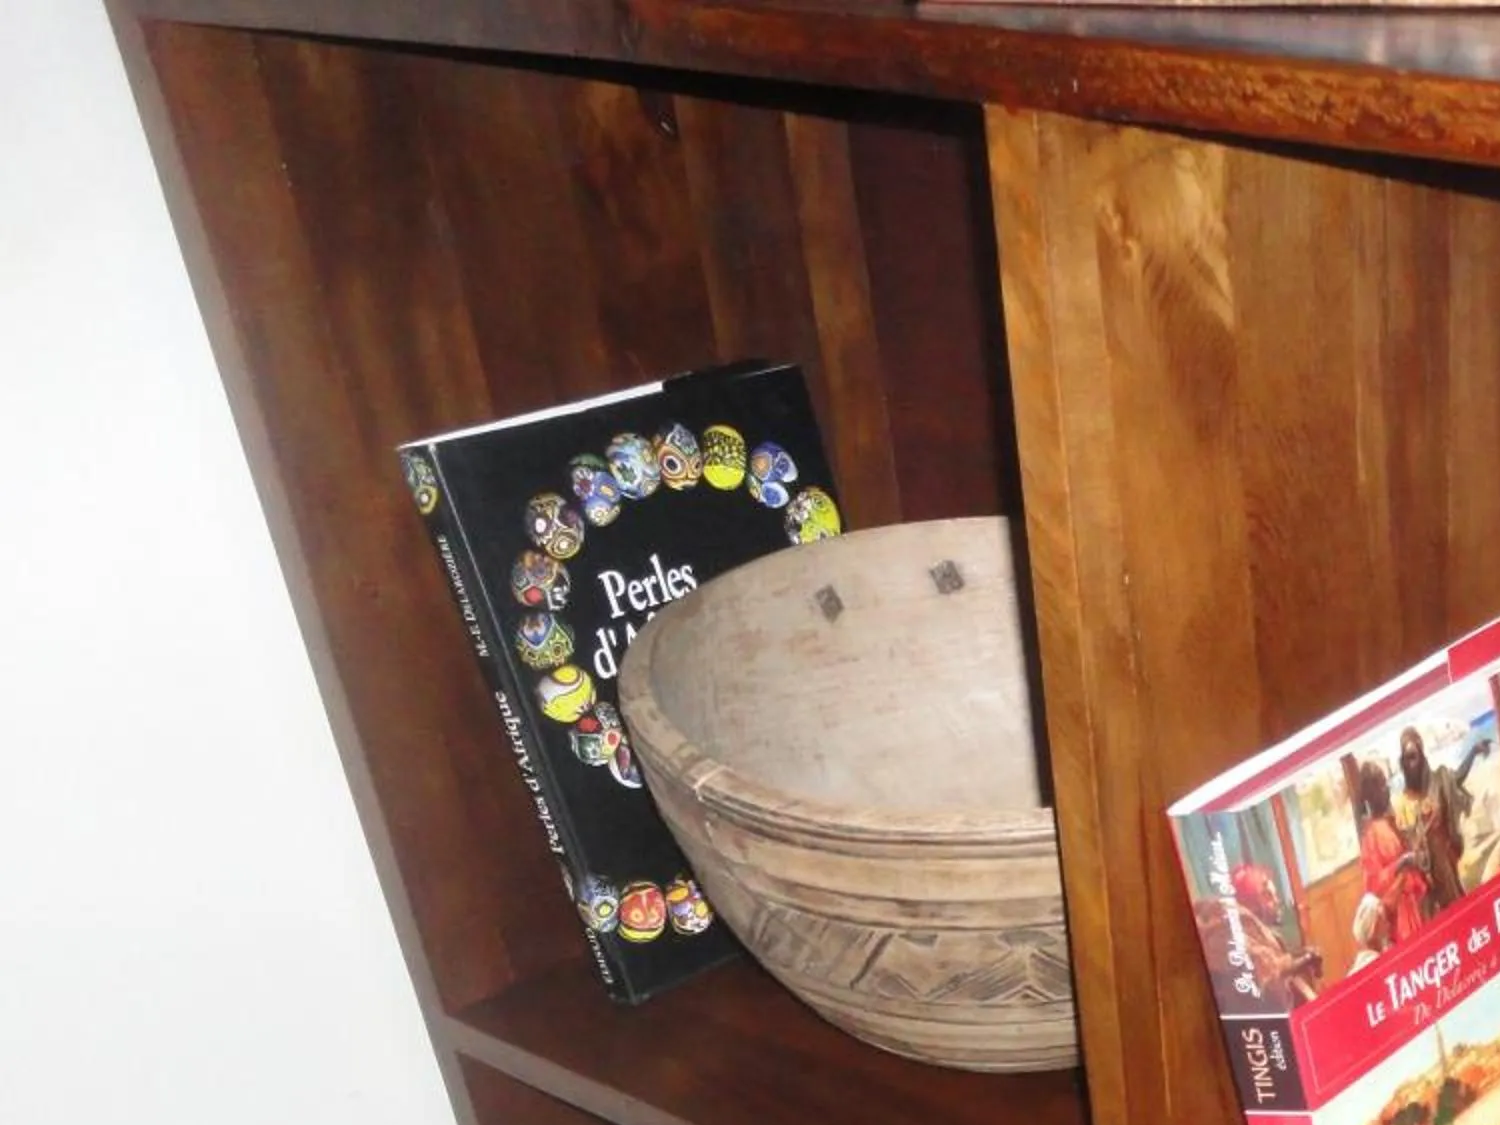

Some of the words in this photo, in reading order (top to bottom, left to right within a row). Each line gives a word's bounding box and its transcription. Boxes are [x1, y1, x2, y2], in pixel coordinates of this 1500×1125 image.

[597, 552, 698, 619] Perles
[494, 689, 543, 792] d'Afrique
[530, 793, 567, 857] Perles
[1384, 941, 1460, 1010] TANGER
[1467, 925, 1491, 954] des
[1241, 1027, 1276, 1104] TINGIS
